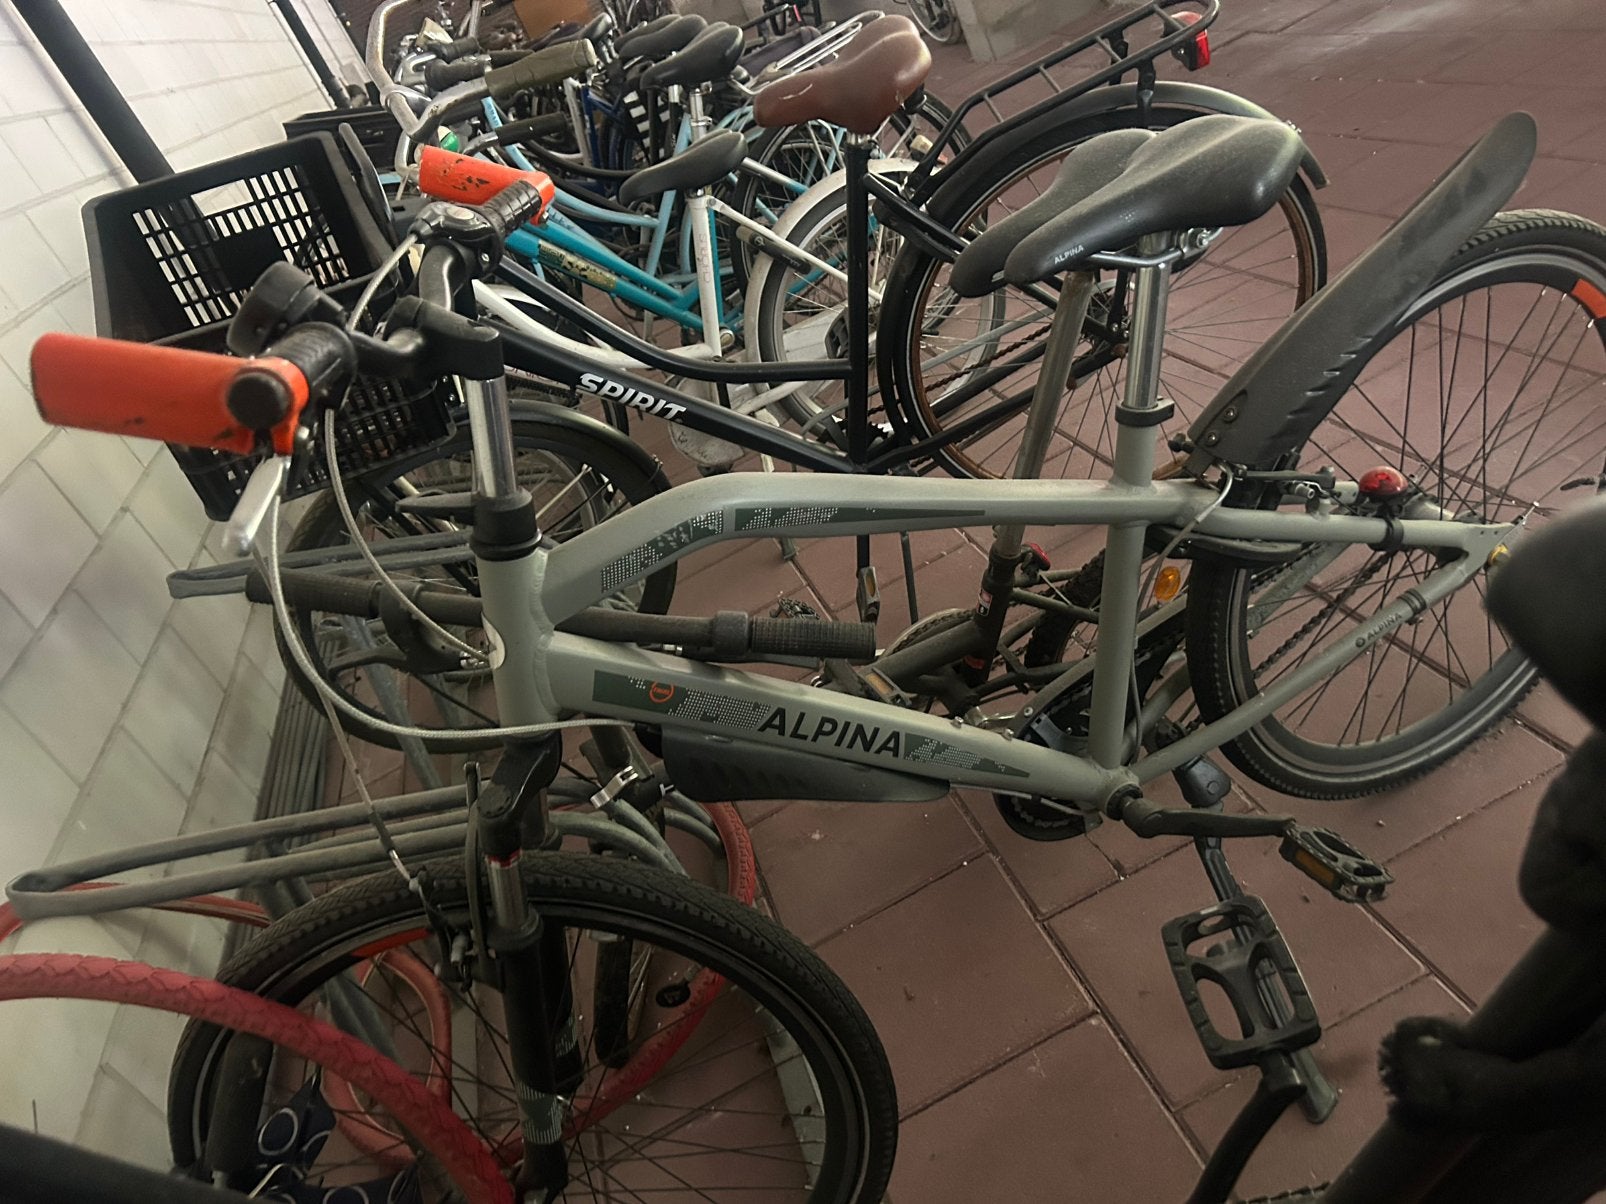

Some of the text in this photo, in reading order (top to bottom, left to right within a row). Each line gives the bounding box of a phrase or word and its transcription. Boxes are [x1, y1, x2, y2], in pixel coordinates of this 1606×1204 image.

[1054, 244, 1084, 264] ALPINA
[580, 372, 686, 421] SPIRIT
[1367, 612, 1402, 640] ALPINA
[757, 706, 900, 758] ALPINA
